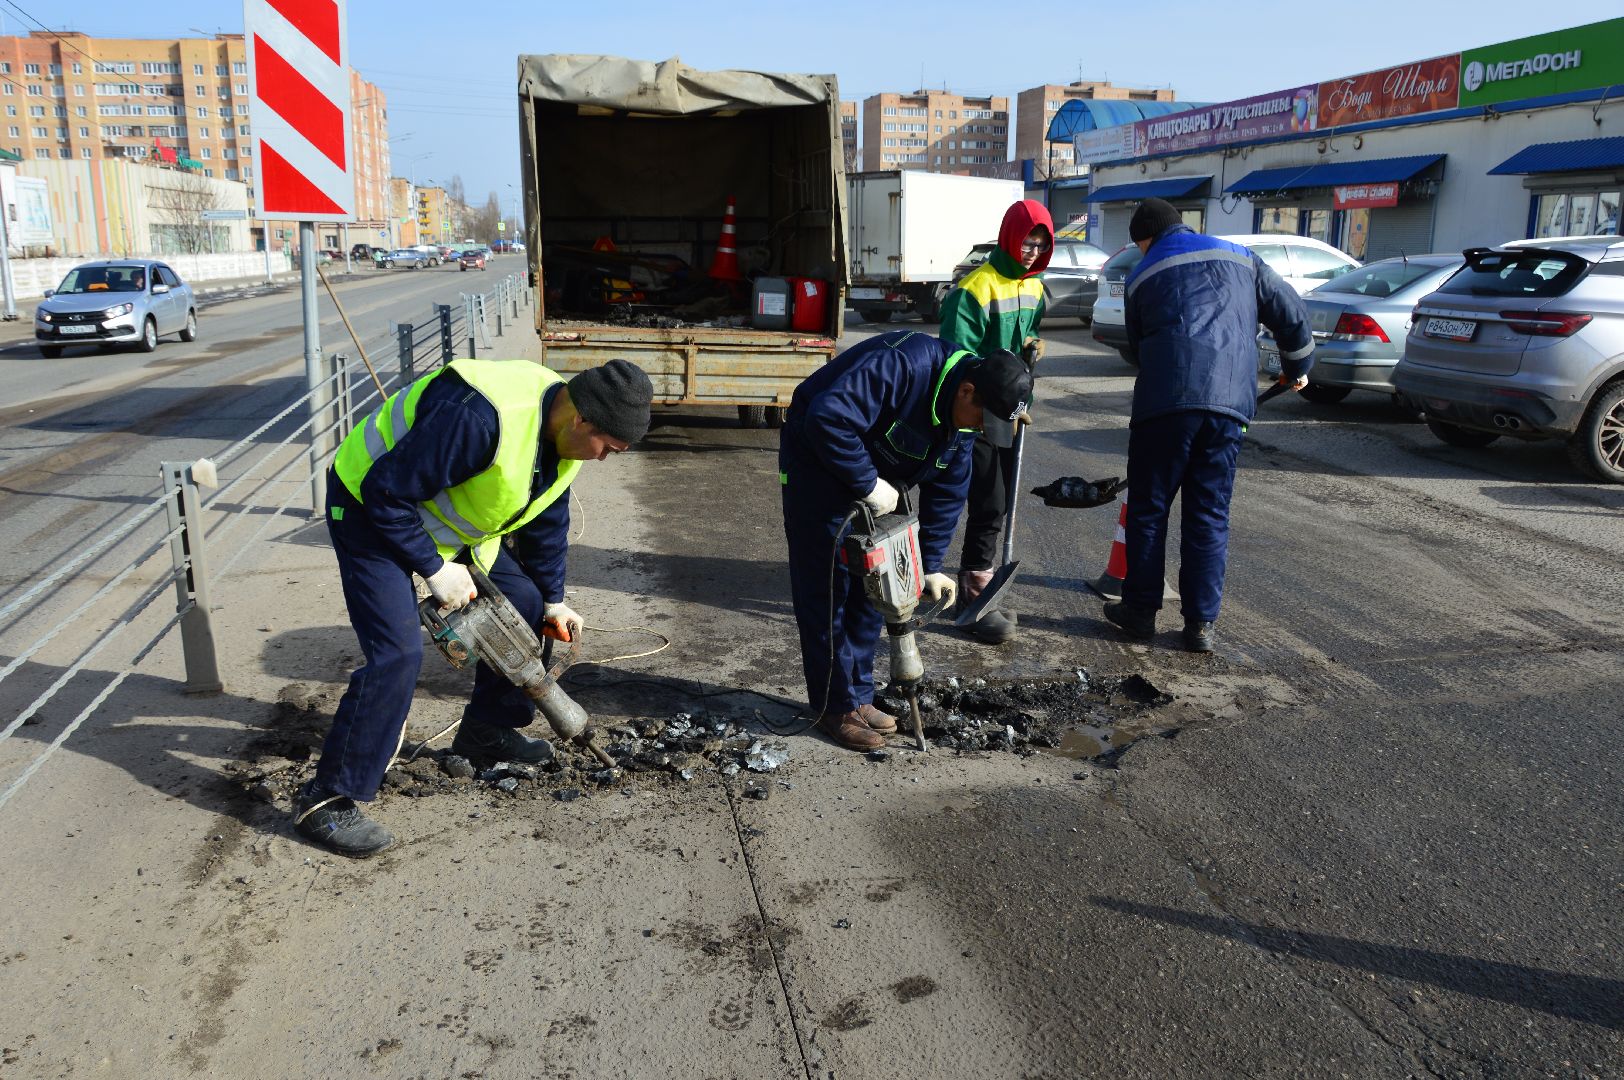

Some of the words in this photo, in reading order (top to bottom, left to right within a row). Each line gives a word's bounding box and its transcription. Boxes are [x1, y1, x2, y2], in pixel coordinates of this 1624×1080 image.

[1328, 79, 1373, 114] Боди
[1383, 65, 1448, 104] Шарм
[1148, 113, 1211, 140] КАНЦТОВАРЫ
[1460, 321, 1474, 332] 797
